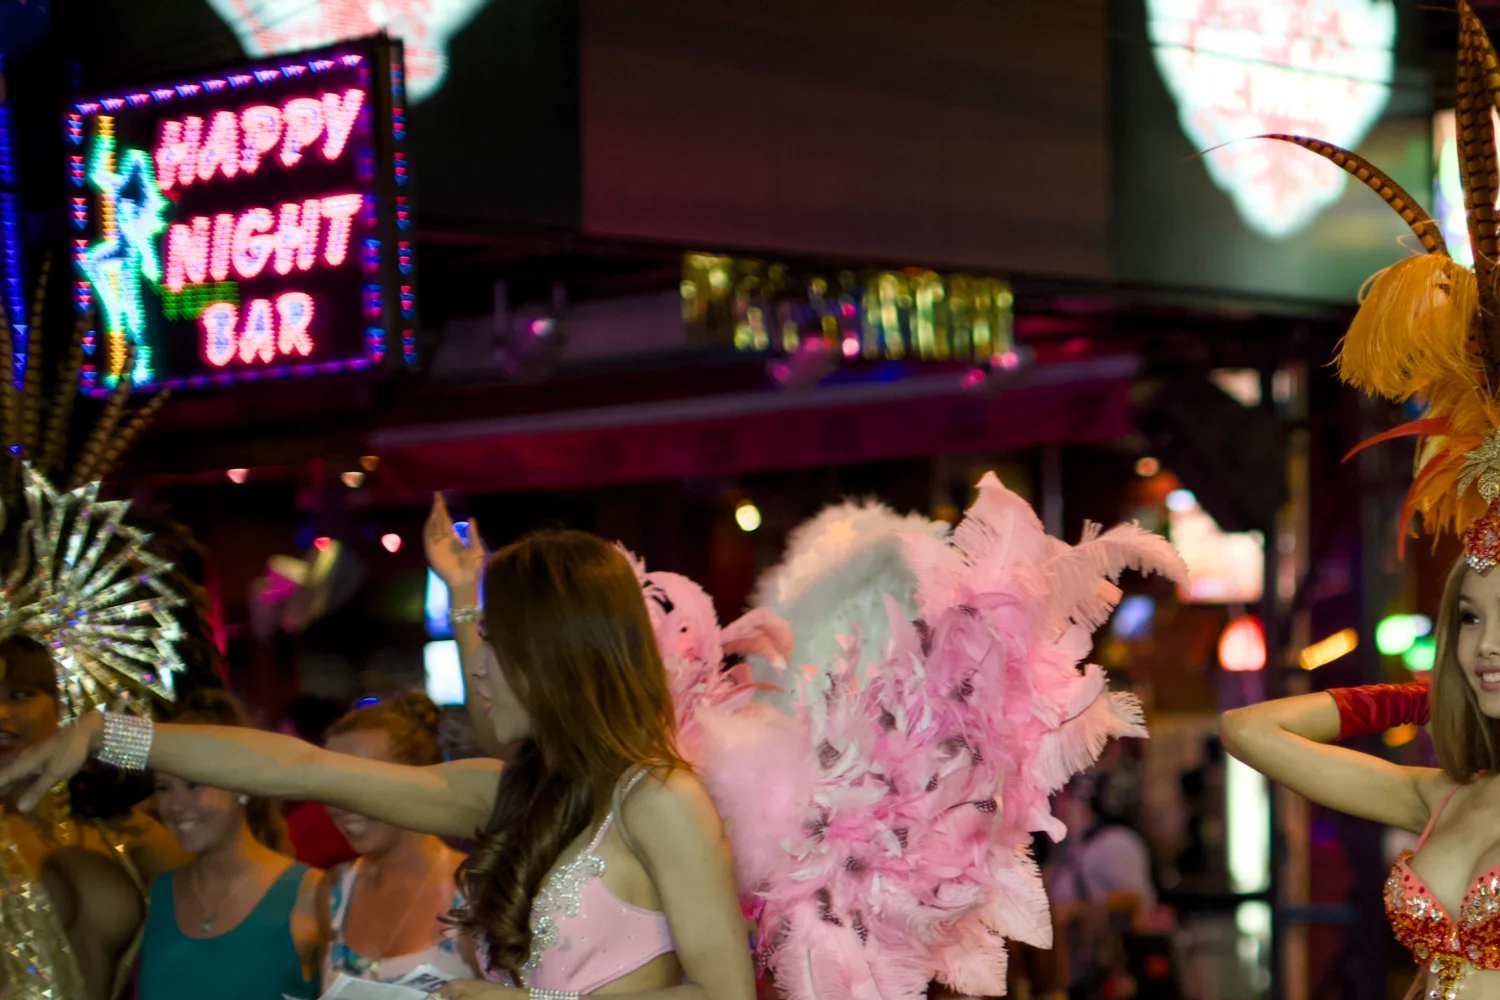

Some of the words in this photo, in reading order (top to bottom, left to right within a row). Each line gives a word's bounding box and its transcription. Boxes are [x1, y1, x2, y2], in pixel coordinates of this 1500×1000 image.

[154, 88, 366, 191] HAPPY
[165, 193, 363, 293] NIGHT
[201, 291, 315, 367] BAR
